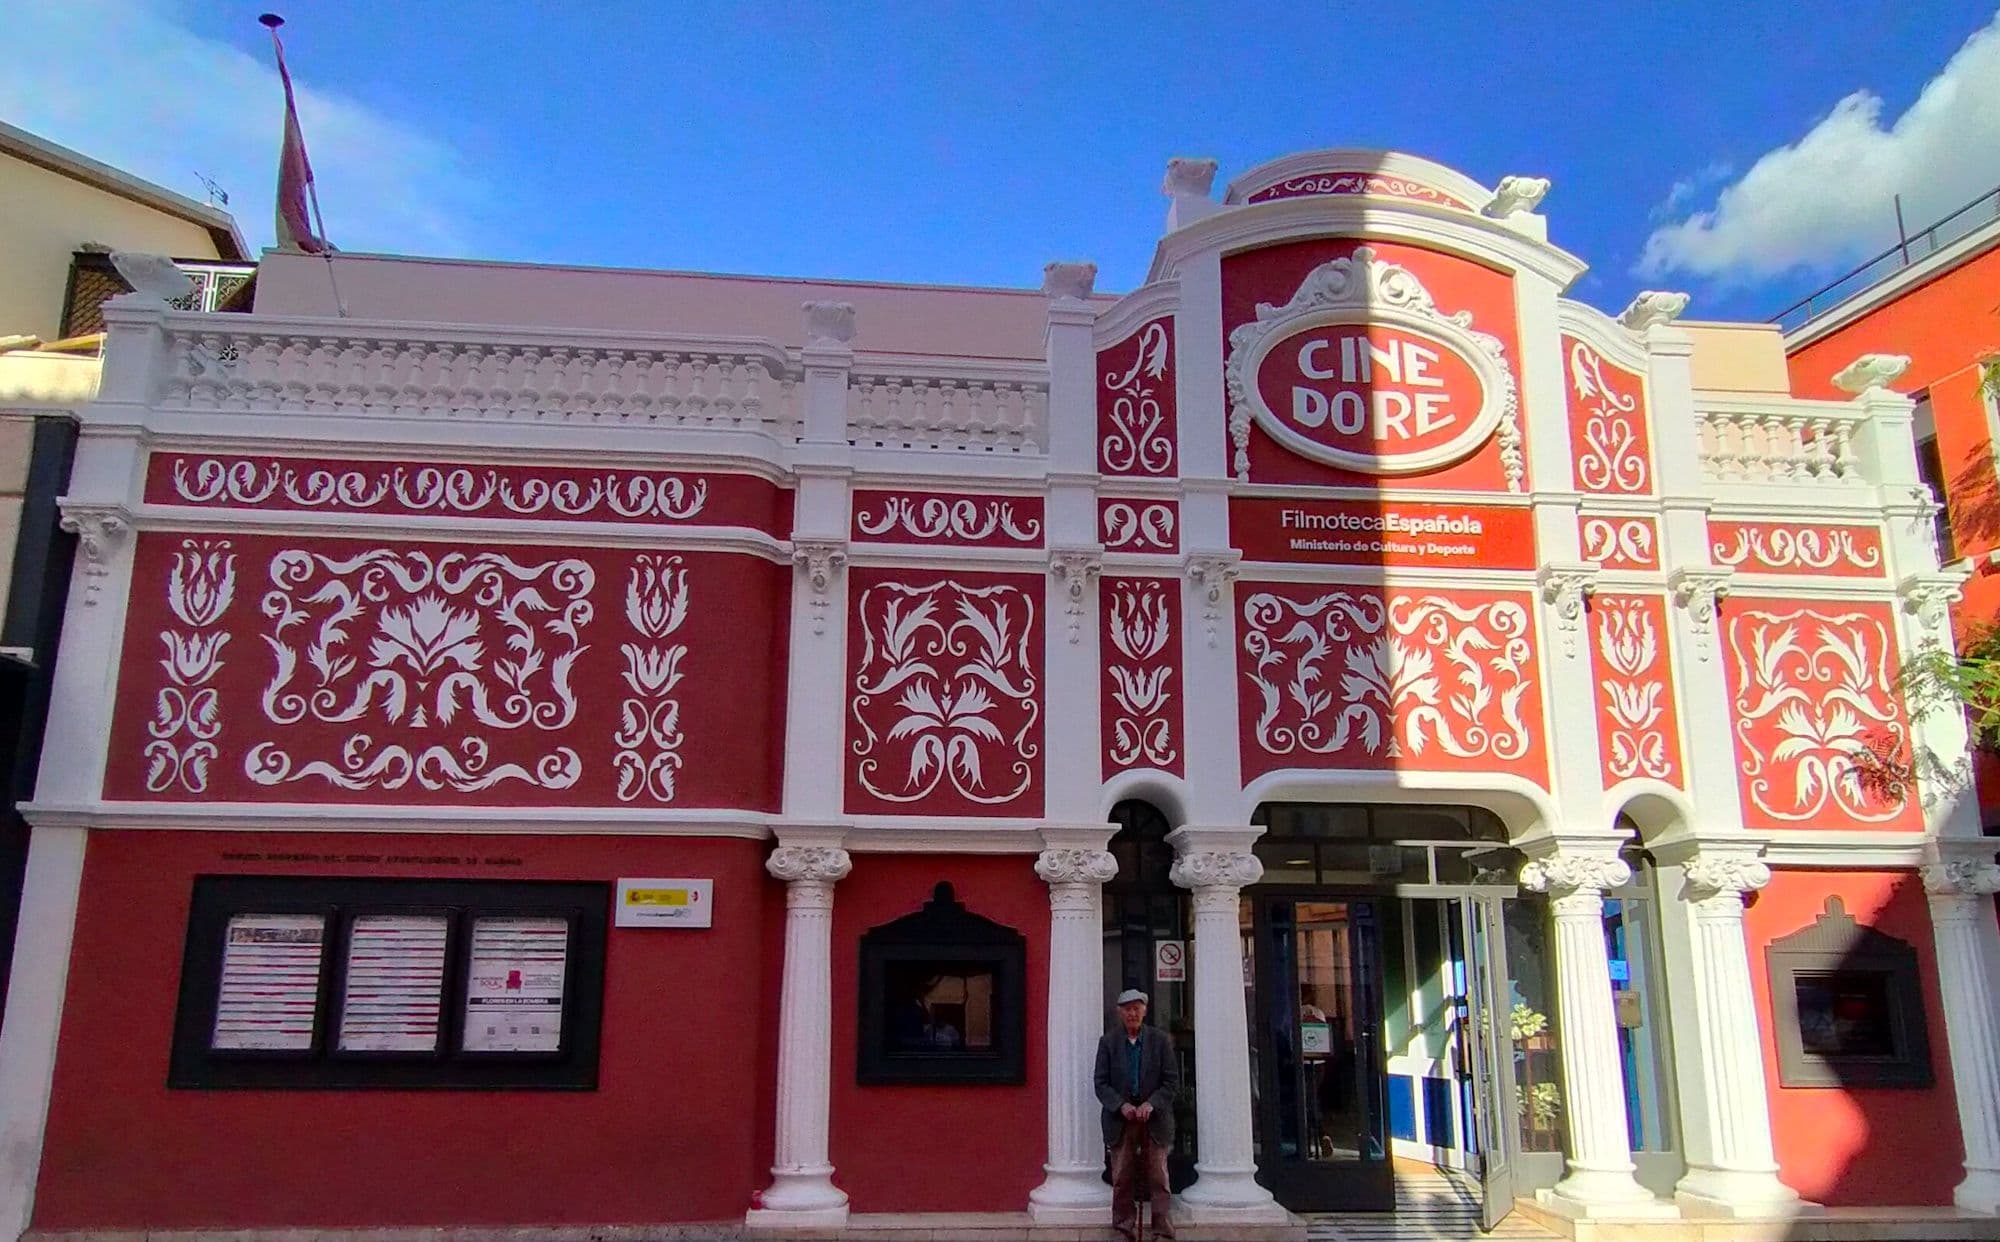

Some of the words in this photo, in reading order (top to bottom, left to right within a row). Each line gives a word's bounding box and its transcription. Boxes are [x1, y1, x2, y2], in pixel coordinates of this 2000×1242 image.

[1298, 336, 1444, 387] CINE
[1292, 386, 1456, 440] DORE
[1290, 539, 1352, 551] Ministerio
[1353, 541, 1369, 551] de
[1370, 541, 1417, 553] Cultura
[1417, 544, 1426, 556] y
[1427, 543, 1476, 556] Deporte
